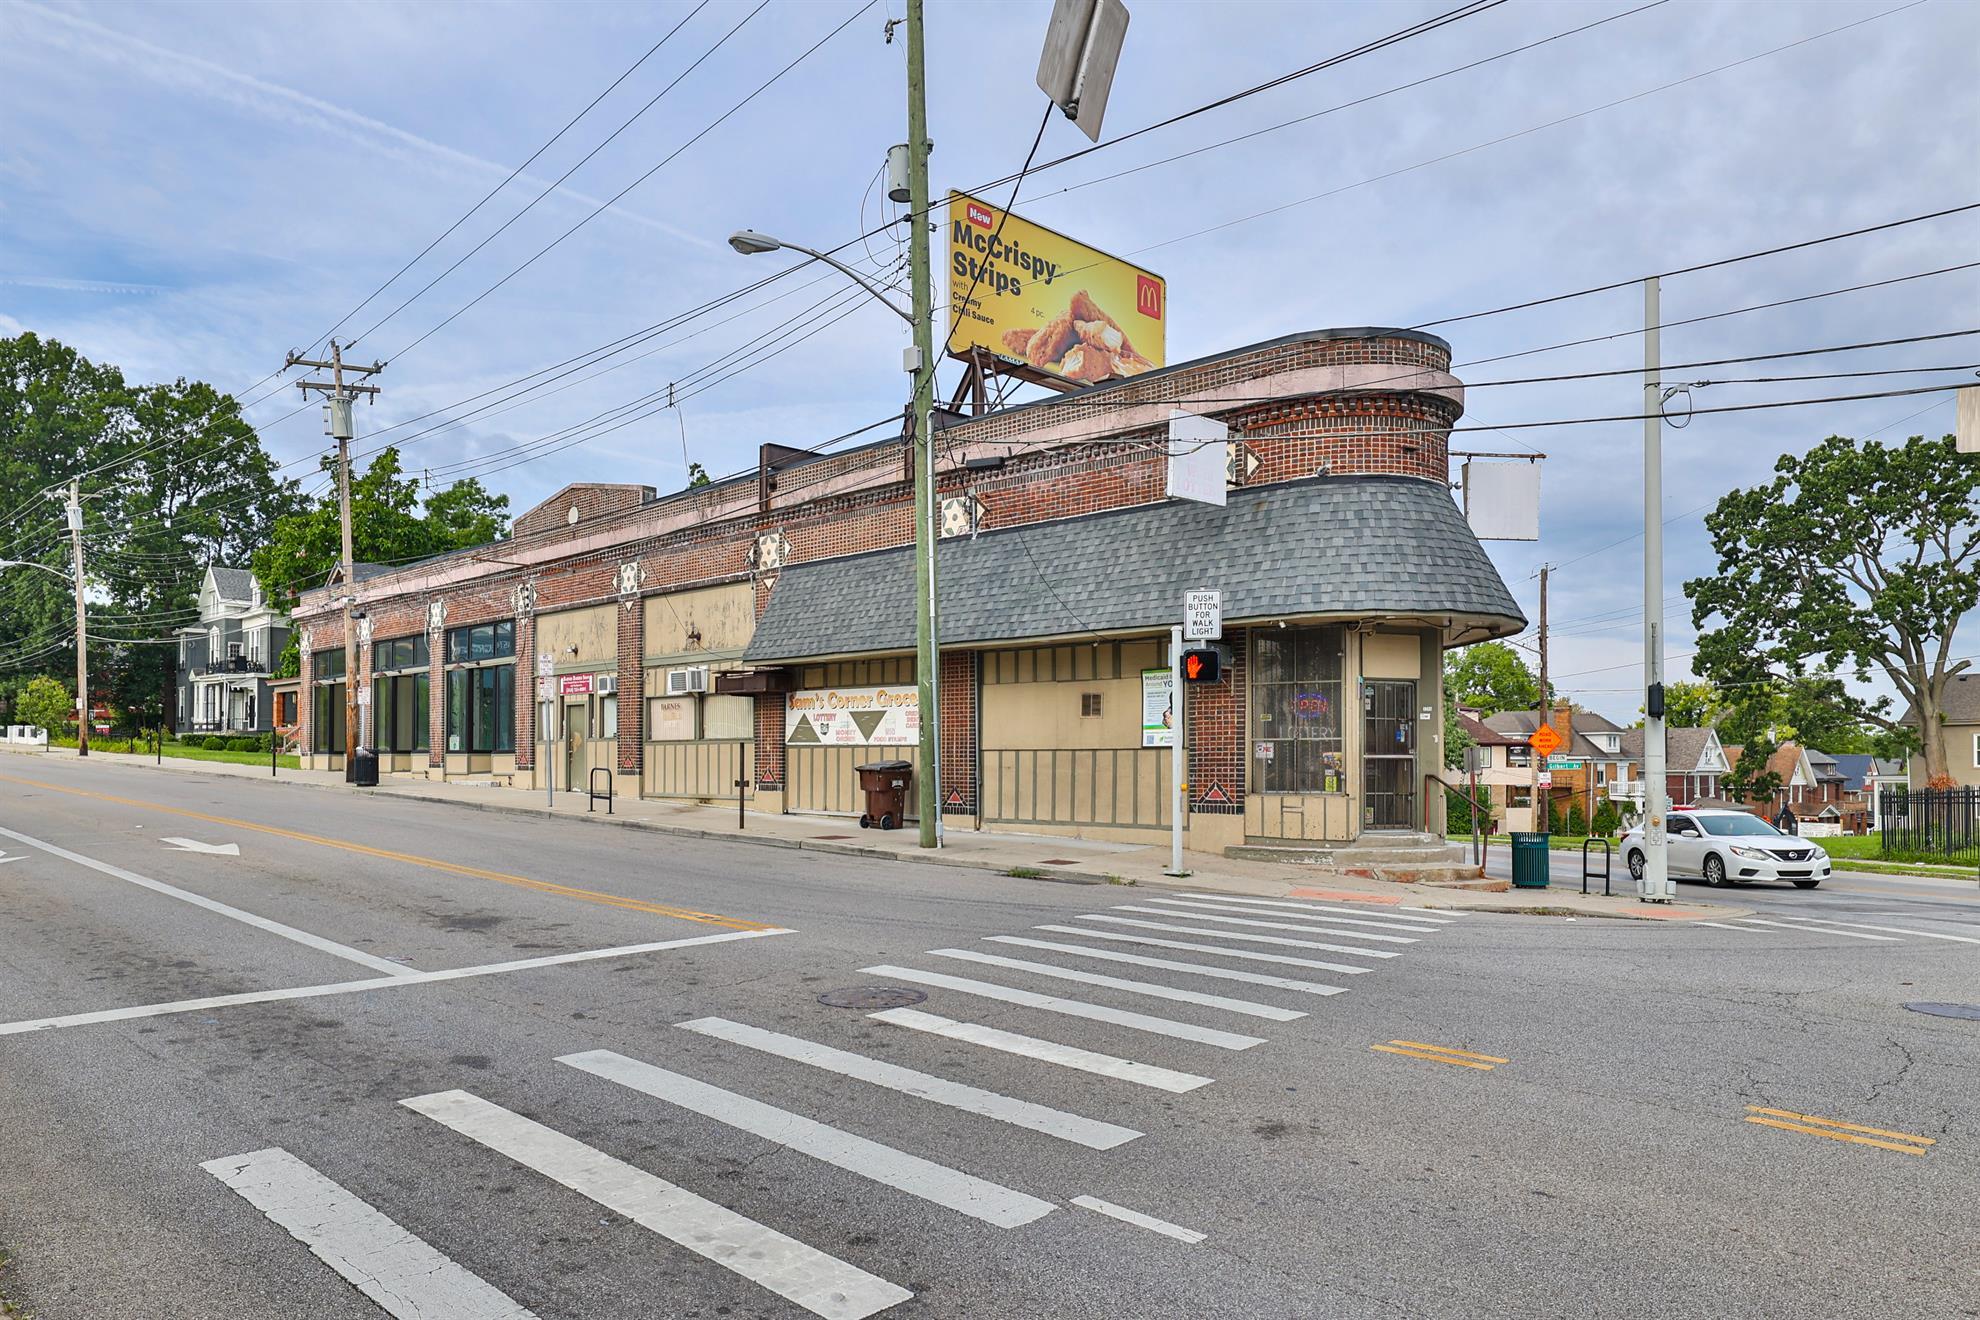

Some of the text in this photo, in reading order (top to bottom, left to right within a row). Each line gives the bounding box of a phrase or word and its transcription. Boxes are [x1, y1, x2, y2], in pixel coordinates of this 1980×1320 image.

[969, 207, 991, 225] New
[953, 251, 1021, 297] Strips
[953, 280, 969, 291] with
[952, 291, 982, 310] Creamy
[952, 304, 995, 325] Chili Sauce
[1030, 307, 1036, 315] 4
[1192, 594, 1214, 602] PUSH
[1188, 602, 1218, 610] BUTTON
[1192, 619, 1214, 627] WALK
[1191, 627, 1214, 636] LIGHT
[1144, 673, 1169, 681] Medicaid
[1162, 680, 1173, 688] YO
[828, 691, 874, 709] Corner
[876, 689, 919, 708] Groce
[1289, 699, 1329, 714] OPEN
[813, 713, 837, 722] LOTTERY
[1279, 726, 1337, 741] LOTTERY
